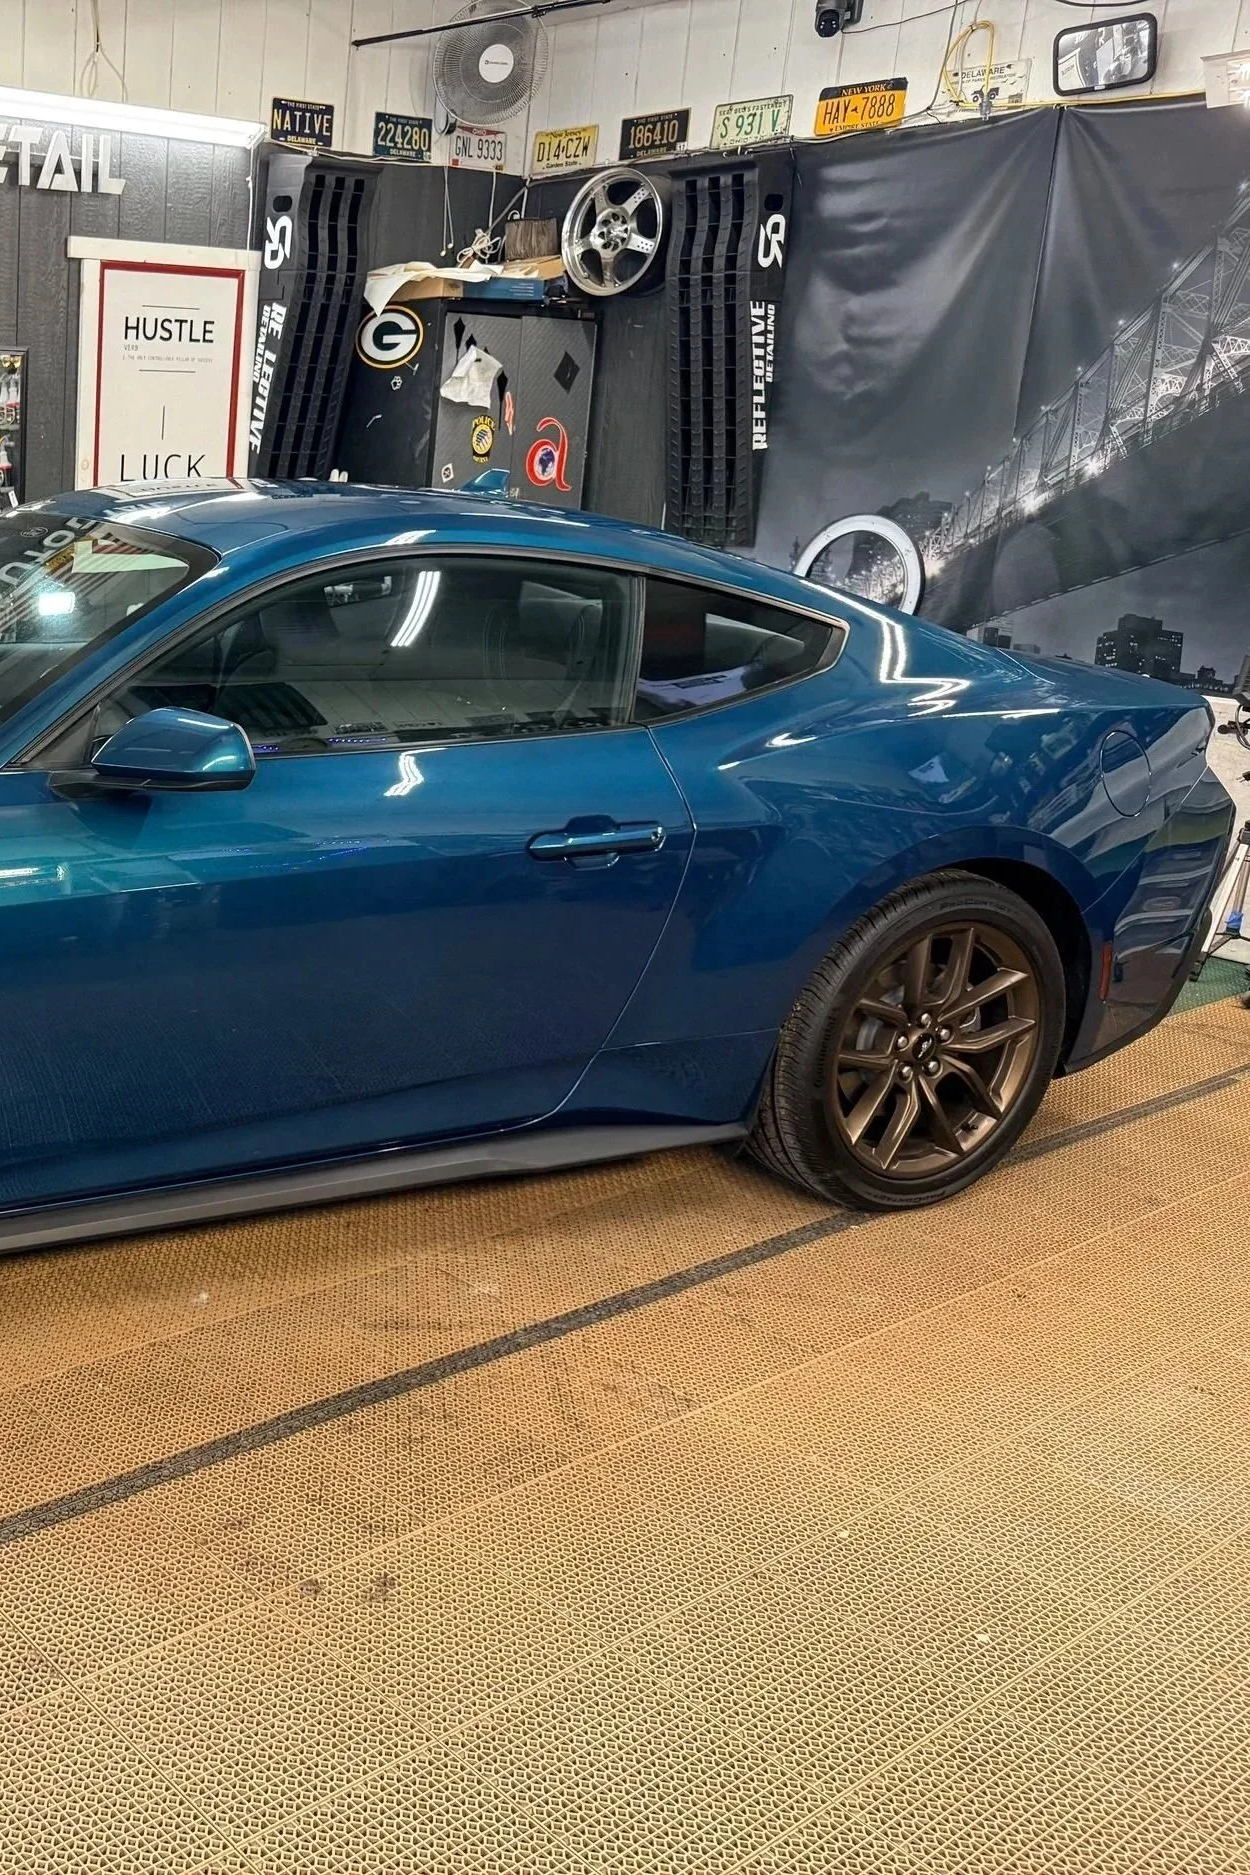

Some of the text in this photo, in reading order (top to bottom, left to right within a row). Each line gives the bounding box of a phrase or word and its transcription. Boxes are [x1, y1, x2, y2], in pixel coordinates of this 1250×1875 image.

[841, 82, 887, 97] NEW YORK
[273, 109, 332, 136] NATIVE
[736, 111, 763, 137] 931
[823, 94, 896, 126] HAY 7888
[377, 121, 429, 151] 224280
[455, 135, 503, 161] GNL 9333
[565, 136, 591, 158] CZW
[628, 120, 679, 149] 186410
[124, 316, 215, 344] HUSTLE
[750, 301, 768, 450] REFLECTIVE
[120, 454, 206, 482] LUCK
